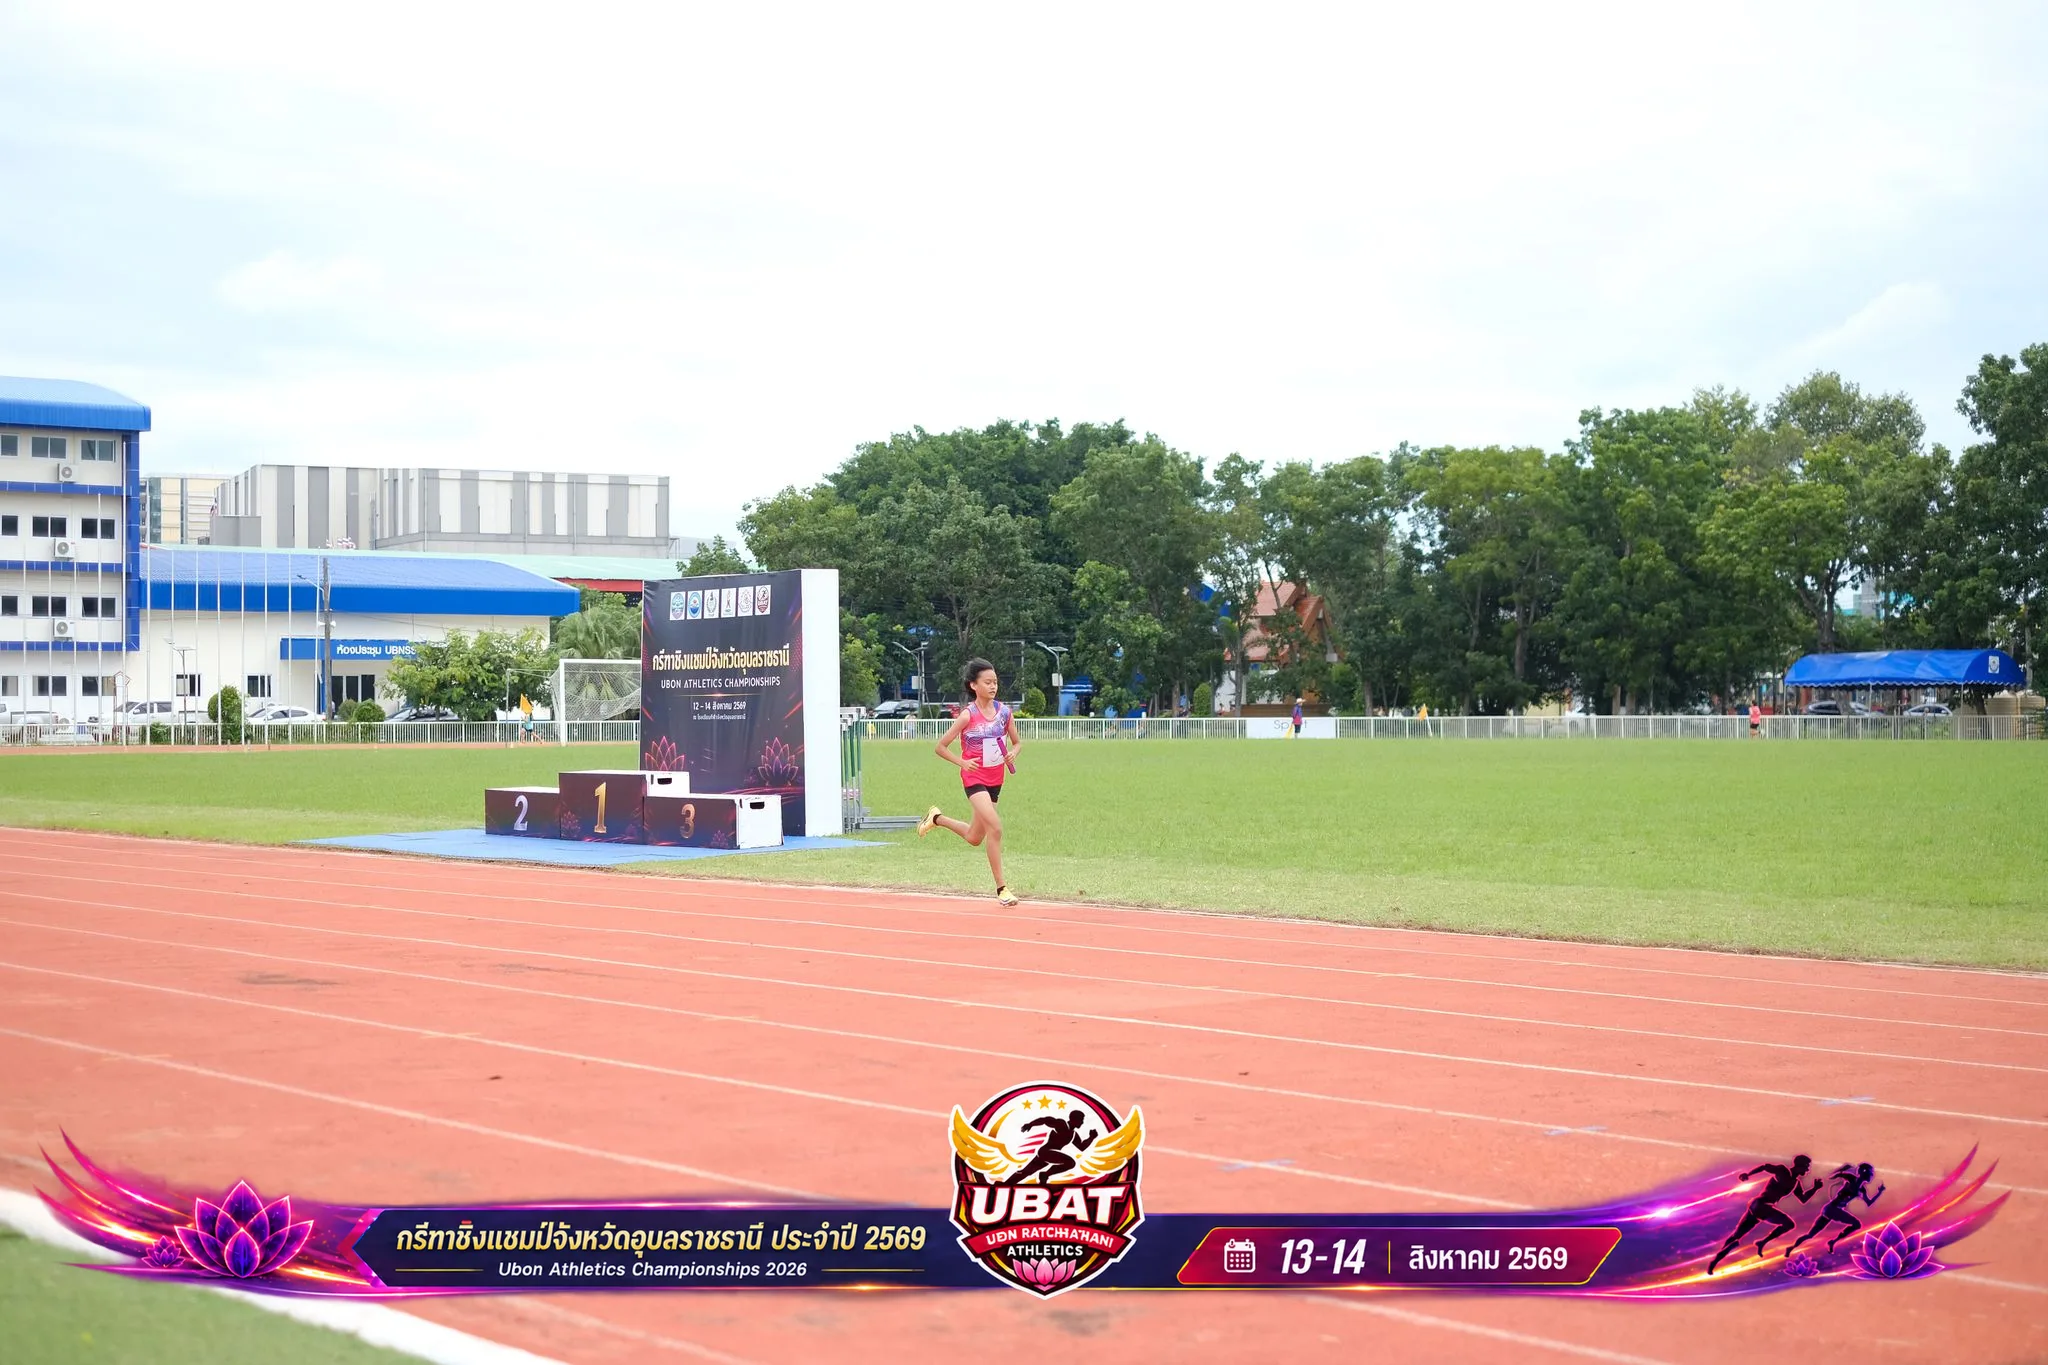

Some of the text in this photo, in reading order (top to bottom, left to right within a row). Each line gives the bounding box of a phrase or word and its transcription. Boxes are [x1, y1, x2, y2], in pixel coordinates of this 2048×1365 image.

[661, 676, 780, 689] UBON ATHLETICS CHAMPIONSHIPS
[693, 702, 699, 710] 12
[705, 702, 711, 710] 14
[733, 701, 747, 710] 2569
[513, 794, 529, 831] 2
[594, 782, 607, 834] 1
[681, 803, 696, 839] 3
